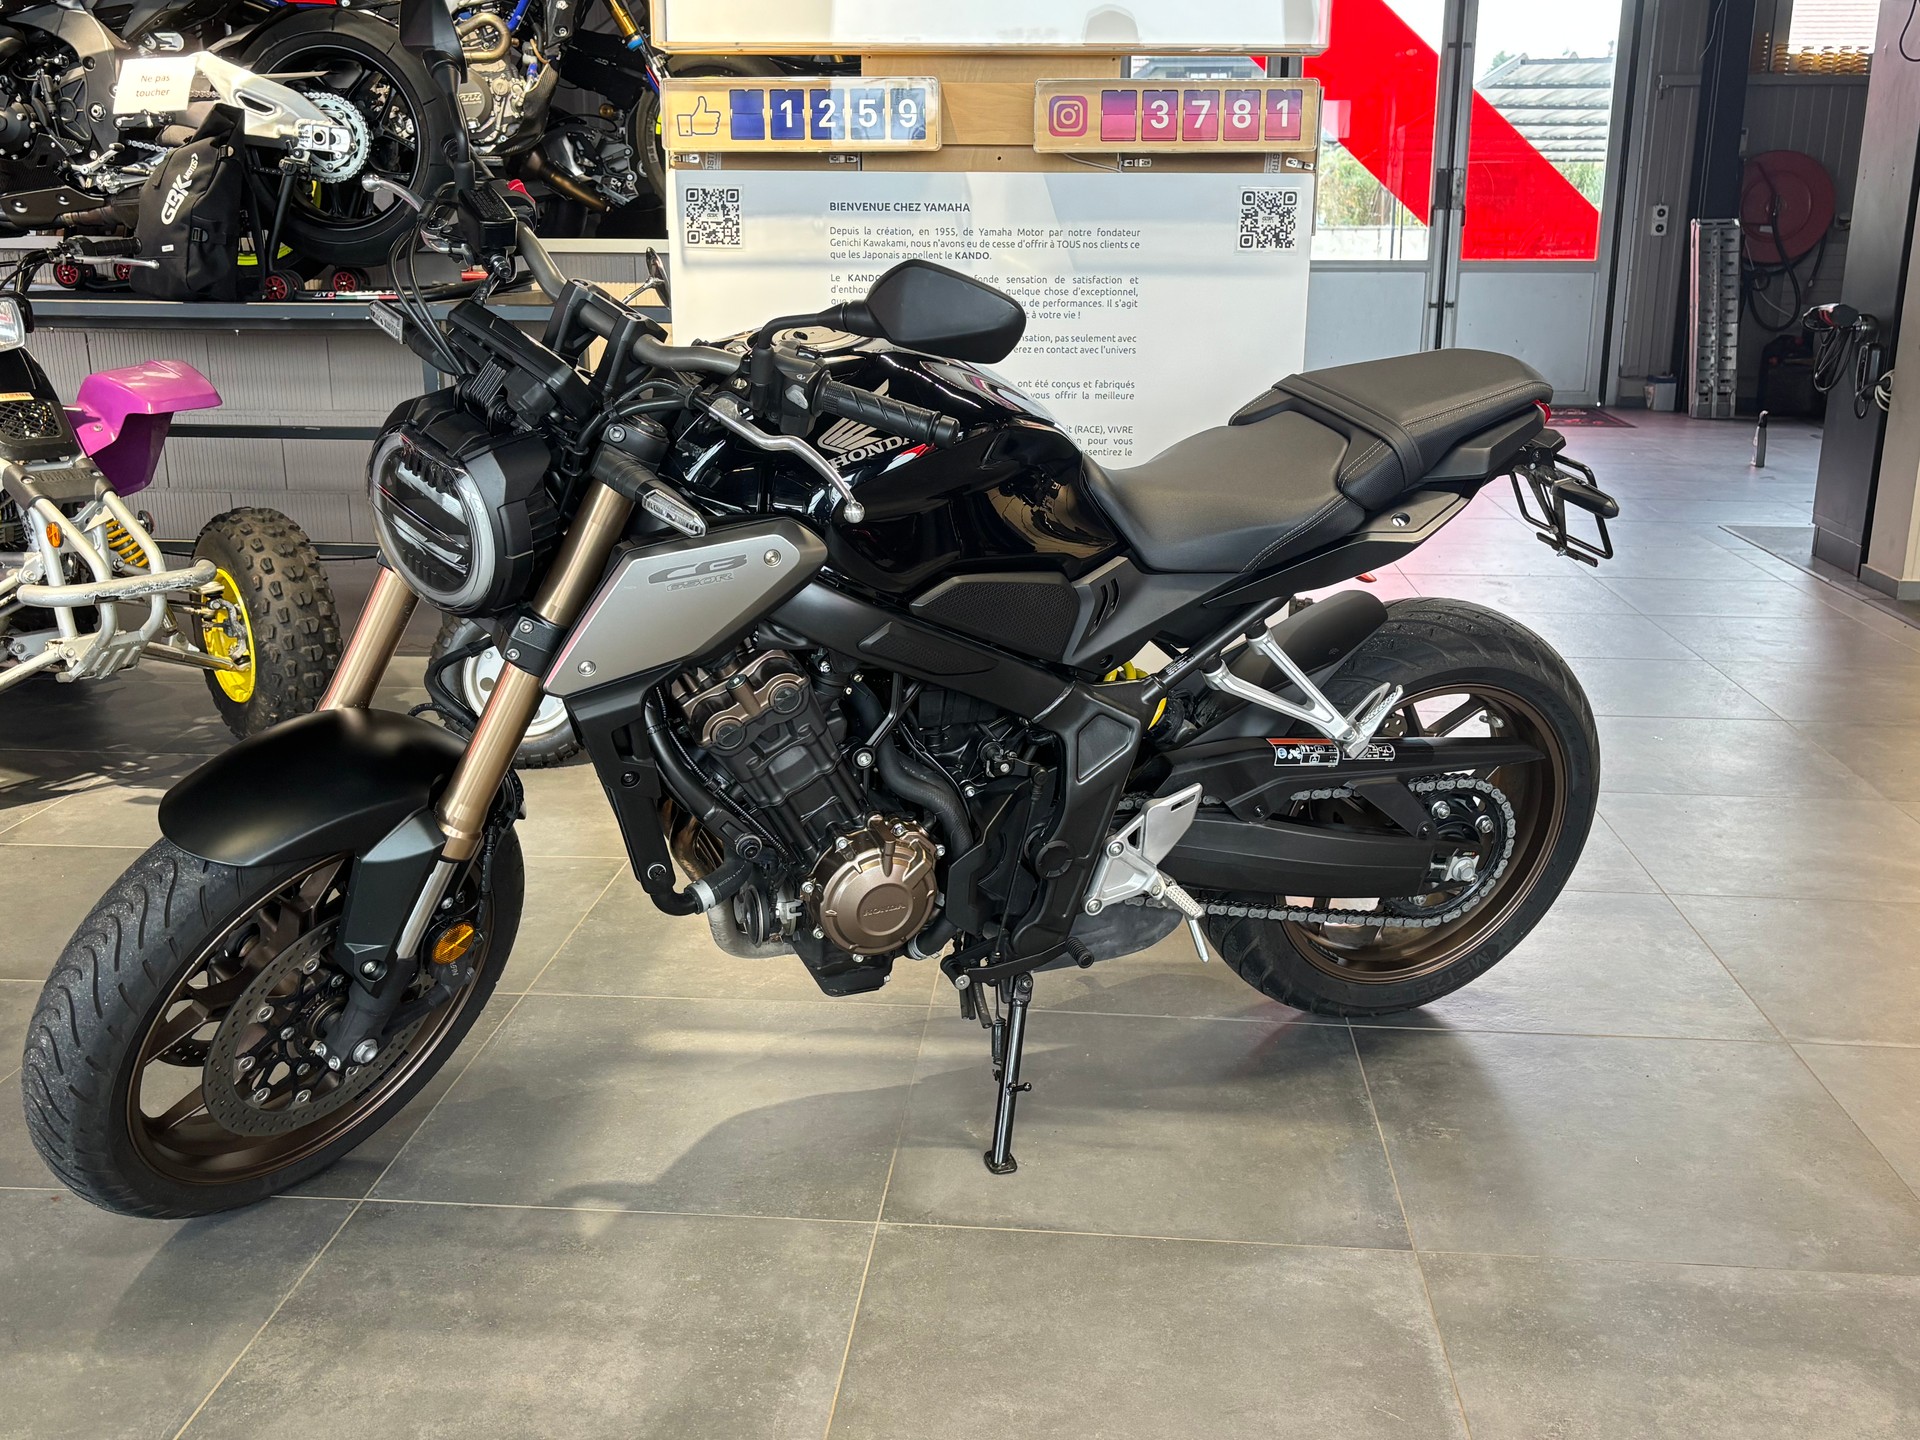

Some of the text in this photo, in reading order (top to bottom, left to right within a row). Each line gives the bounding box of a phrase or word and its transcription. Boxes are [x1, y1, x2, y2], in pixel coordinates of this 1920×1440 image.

[140, 75, 170, 84] Ne pas
[135, 88, 171, 98] toucher
[780, 98, 917, 128] 1259
[1150, 99, 1288, 129] 3781
[161, 173, 193, 225] GBK
[829, 202, 970, 212] BIENVENUE CHEZ YAMAHA
[829, 227, 860, 238] Depuis
[864, 227, 872, 236] la
[876, 227, 914, 238] création,
[934, 227, 959, 239] 1955,
[962, 227, 974, 237] de
[978, 227, 1012, 237] Yamaha
[1017, 227, 1044, 237] Motor
[1049, 230, 1063, 239] par
[1068, 227, 1092, 237] notre
[1096, 227, 1141, 237] fondateur
[830, 239, 862, 248] Genichi
[863, 239, 909, 250] Kawakami,
[933, 239, 965, 248] n'avons
[979, 239, 991, 248] de
[1017, 239, 1048, 248] d'offrir
[1049, 239, 1055, 248] à
[1056, 239, 1081, 248] TOUS
[1100, 239, 1129, 249] clients
[1130, 241, 1140, 249] ce
[830, 250, 992, 261] que les Japonais appellent le KANDO.
[830, 274, 841, 282] Le
[1006, 274, 1048, 284] sensation
[1054, 275, 1066, 284] de
[1072, 275, 1123, 284] satisfaction
[1129, 275, 1139, 284] et
[830, 284, 869, 294] d'enthou
[1044, 287, 1069, 296] chose
[1072, 287, 1138, 298] d'exceptionnel,
[1028, 299, 1040, 307] de
[1042, 299, 1105, 309] performances.
[1106, 299, 1113, 307] Il
[1114, 299, 1138, 309] s'agit
[1031, 311, 1037, 319] à
[1038, 311, 1061, 319] votre
[1063, 311, 1076, 319] vie
[1054, 335, 1070, 344] pas
[1070, 334, 1116, 342] seulement
[1117, 335, 1137, 343] avec
[1046, 346, 1078, 354] contact
[1100, 346, 1137, 354] l'univers
[1017, 380, 1135, 390] ont été conçus et fabriqués
[1054, 391, 1078, 400] offrir
[1082, 391, 1090, 400] la
[1094, 391, 1135, 400] meilleure
[1074, 425, 1106, 435] (RACE),
[1107, 425, 1134, 433] VIVRE
[1087, 438, 1108, 446] pour
[1084, 447, 1133, 456] ssentirez le
[648, 554, 747, 584] CB
[666, 572, 734, 592] 650R
[863, 905, 906, 917] HONDA
